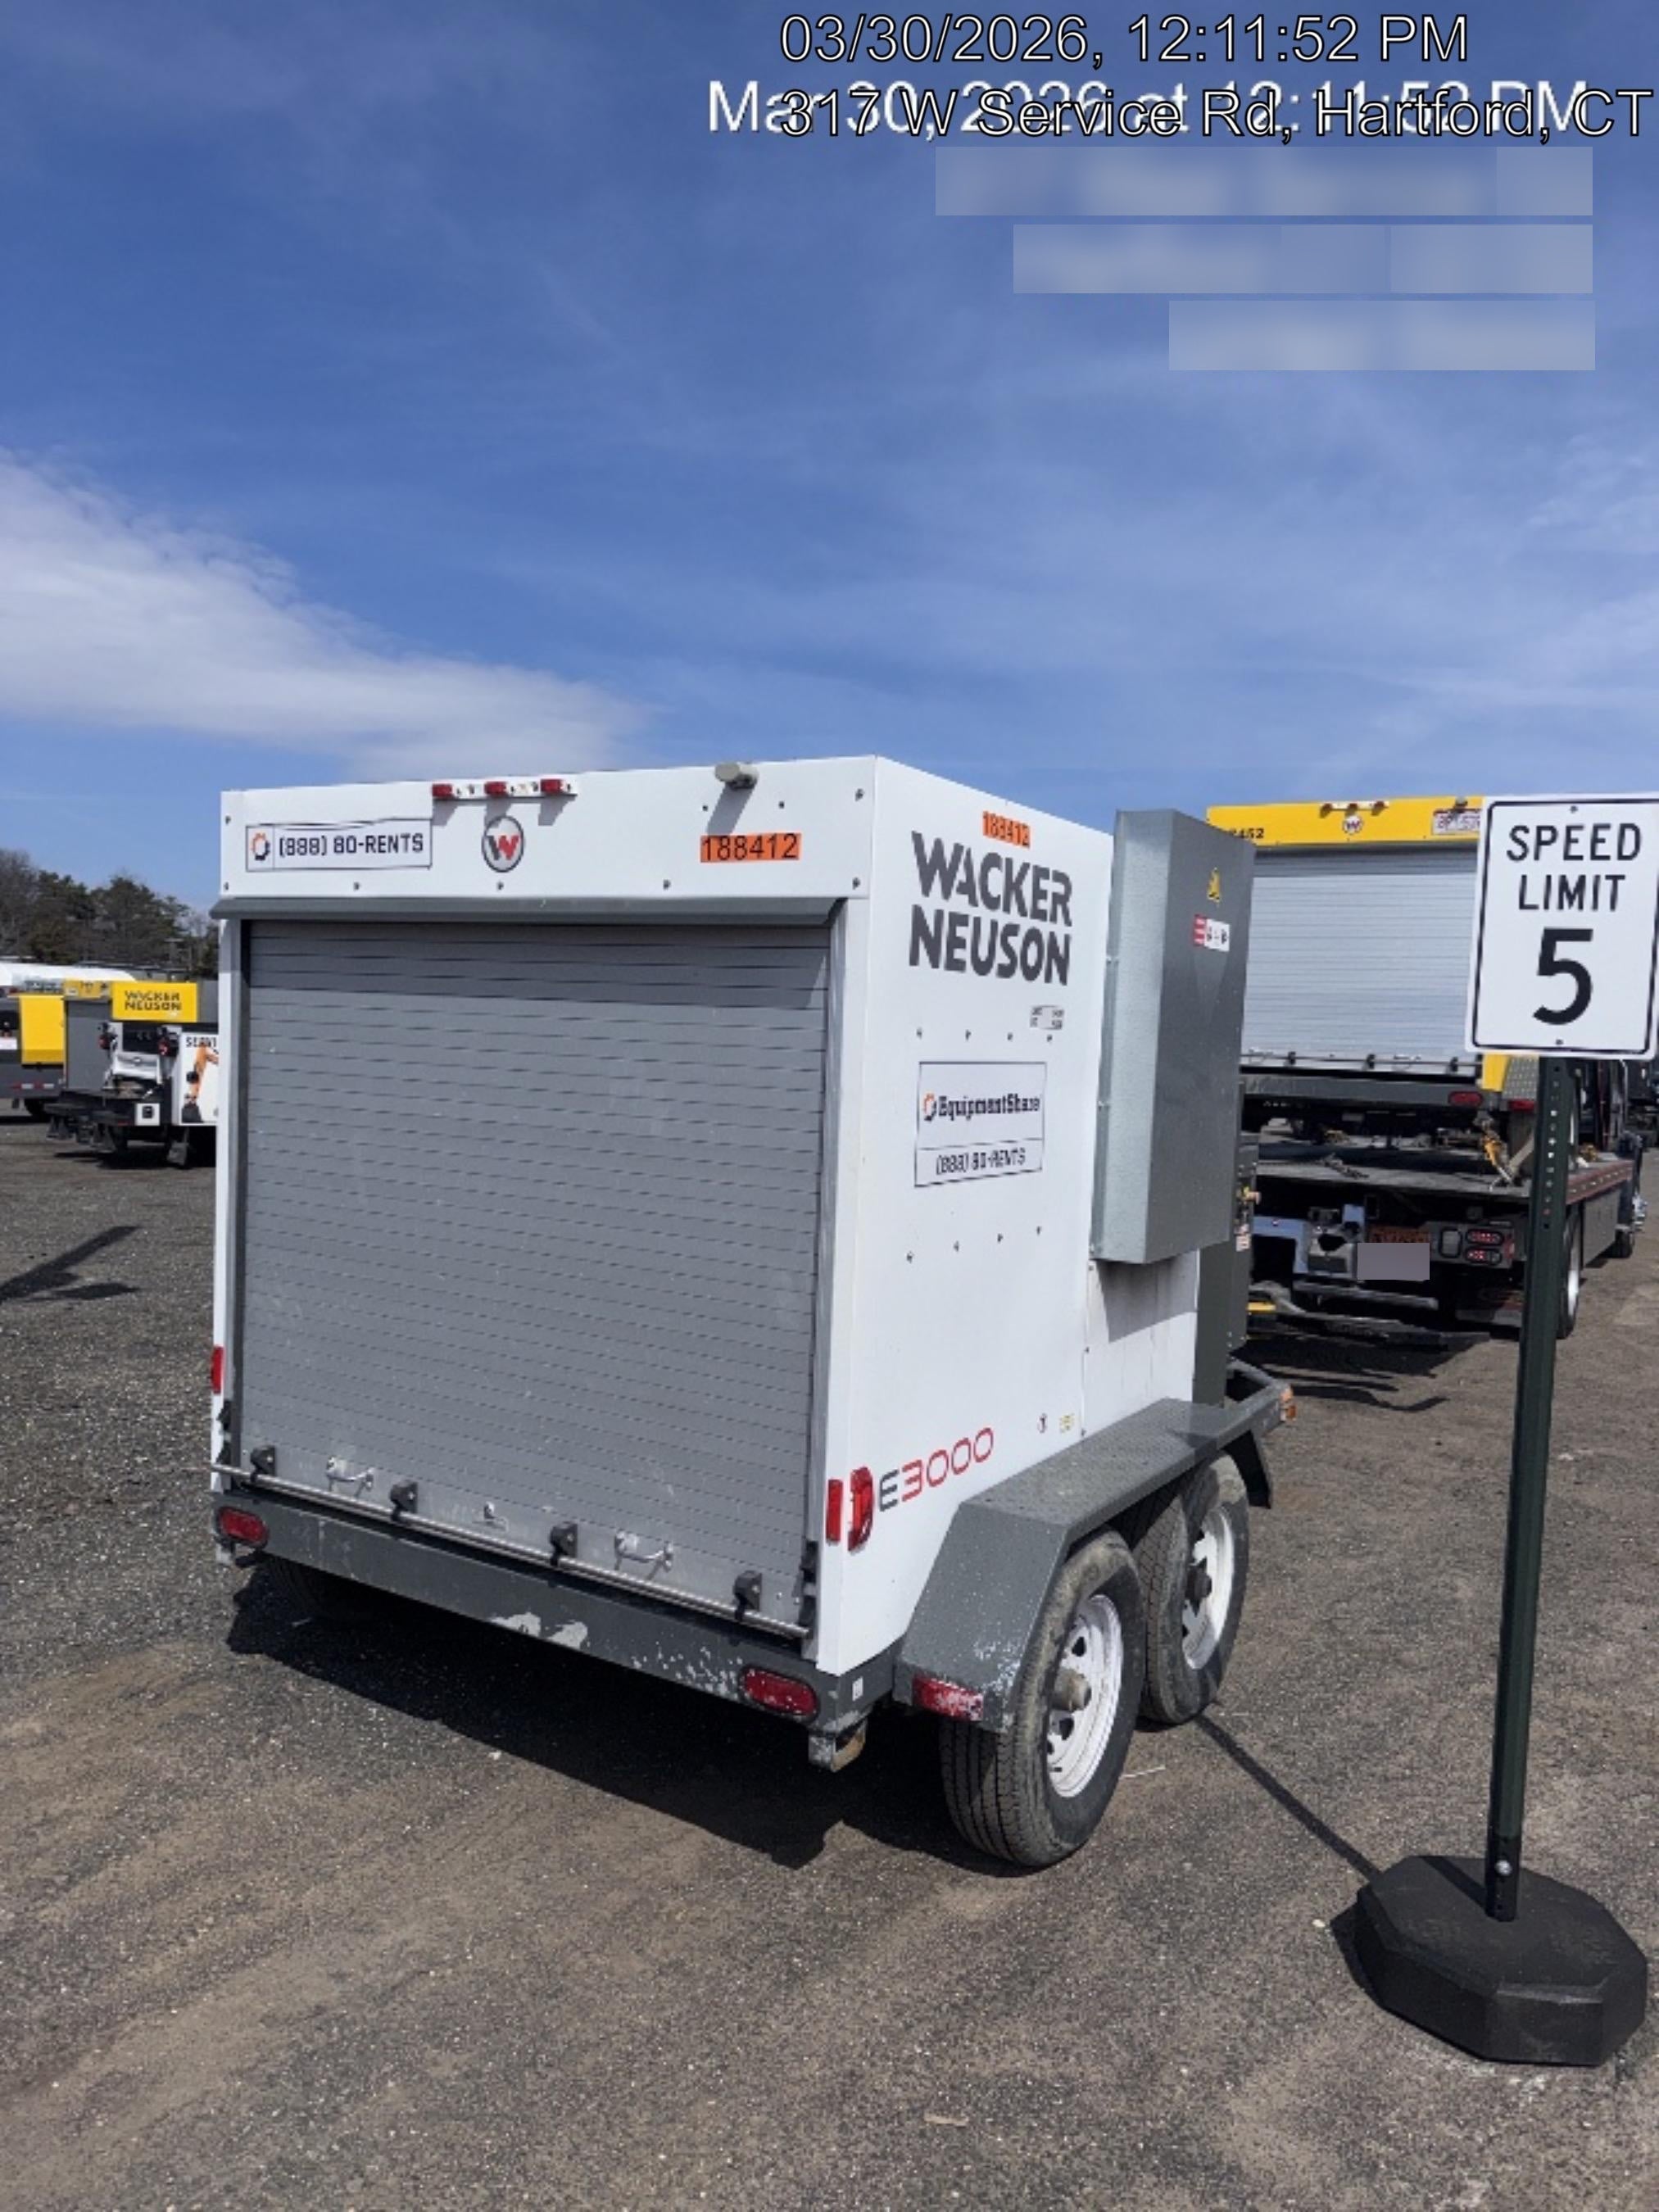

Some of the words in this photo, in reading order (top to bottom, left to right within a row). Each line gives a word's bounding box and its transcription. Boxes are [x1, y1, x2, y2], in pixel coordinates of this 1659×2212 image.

[279, 835, 328, 858] (888)
[702, 832, 798, 861] 188412
[1506, 823, 1643, 863] SPEED
[910, 830, 1072, 927] WACKER
[1518, 873, 1626, 912] LIMIT
[909, 904, 1072, 986] NEUSON
[1532, 927, 1593, 1026] 5
[938, 1093, 1040, 1122] EquipmentShare
[879, 1426, 994, 1512] E3000
